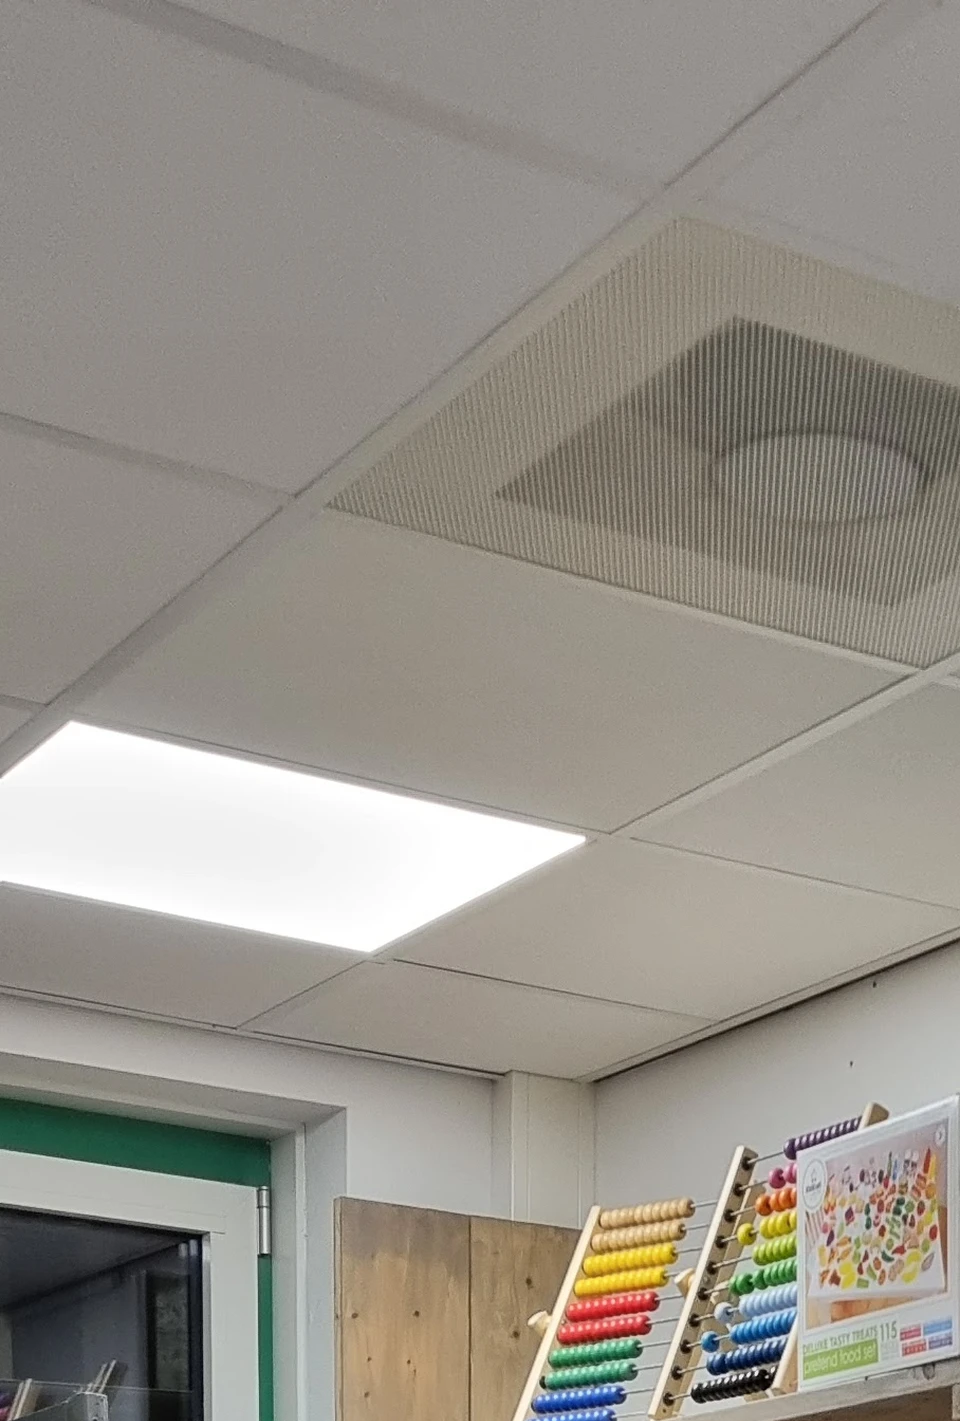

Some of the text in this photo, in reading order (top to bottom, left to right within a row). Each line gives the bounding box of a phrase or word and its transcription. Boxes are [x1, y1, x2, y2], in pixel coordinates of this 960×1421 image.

[830, 1333, 851, 1347] TASTY
[852, 1326, 879, 1341] TREATS
[879, 1321, 898, 1341] 115
[839, 1347, 862, 1364] food
[863, 1343, 877, 1359] set
